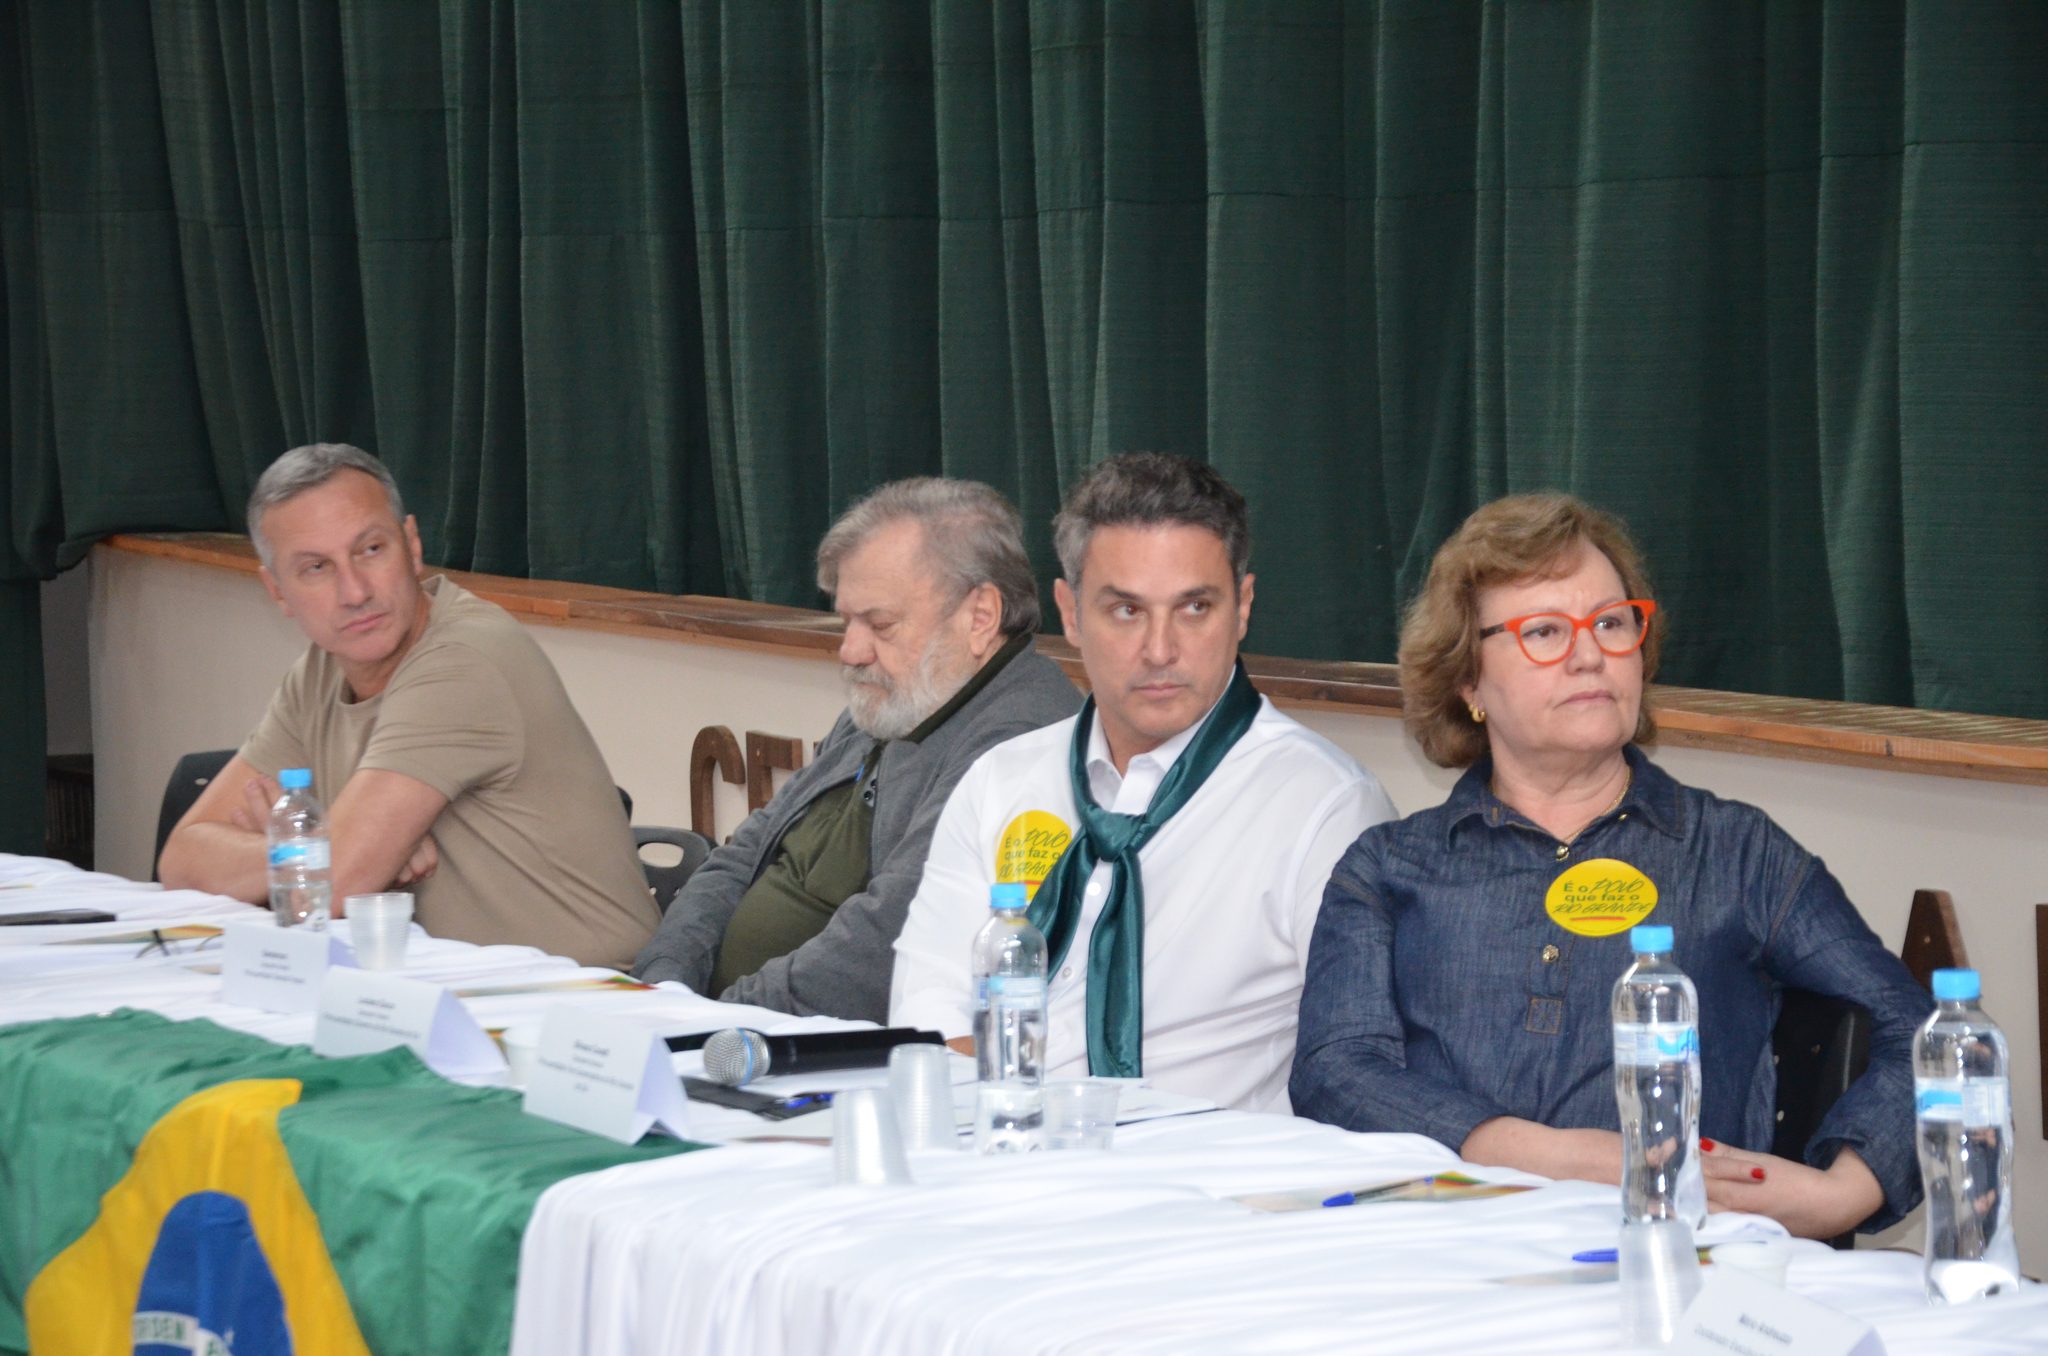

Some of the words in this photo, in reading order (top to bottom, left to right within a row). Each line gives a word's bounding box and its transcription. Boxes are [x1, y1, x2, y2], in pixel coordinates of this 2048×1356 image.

[1024, 828, 1068, 848] POVO
[1028, 846, 1049, 858] faz
[1564, 881, 1574, 892] É
[1578, 884, 1589, 893] o
[1589, 877, 1646, 894] POVO
[1564, 894, 1597, 904] que
[1601, 892, 1626, 902] faz
[1583, 902, 1653, 913] GRANDE
